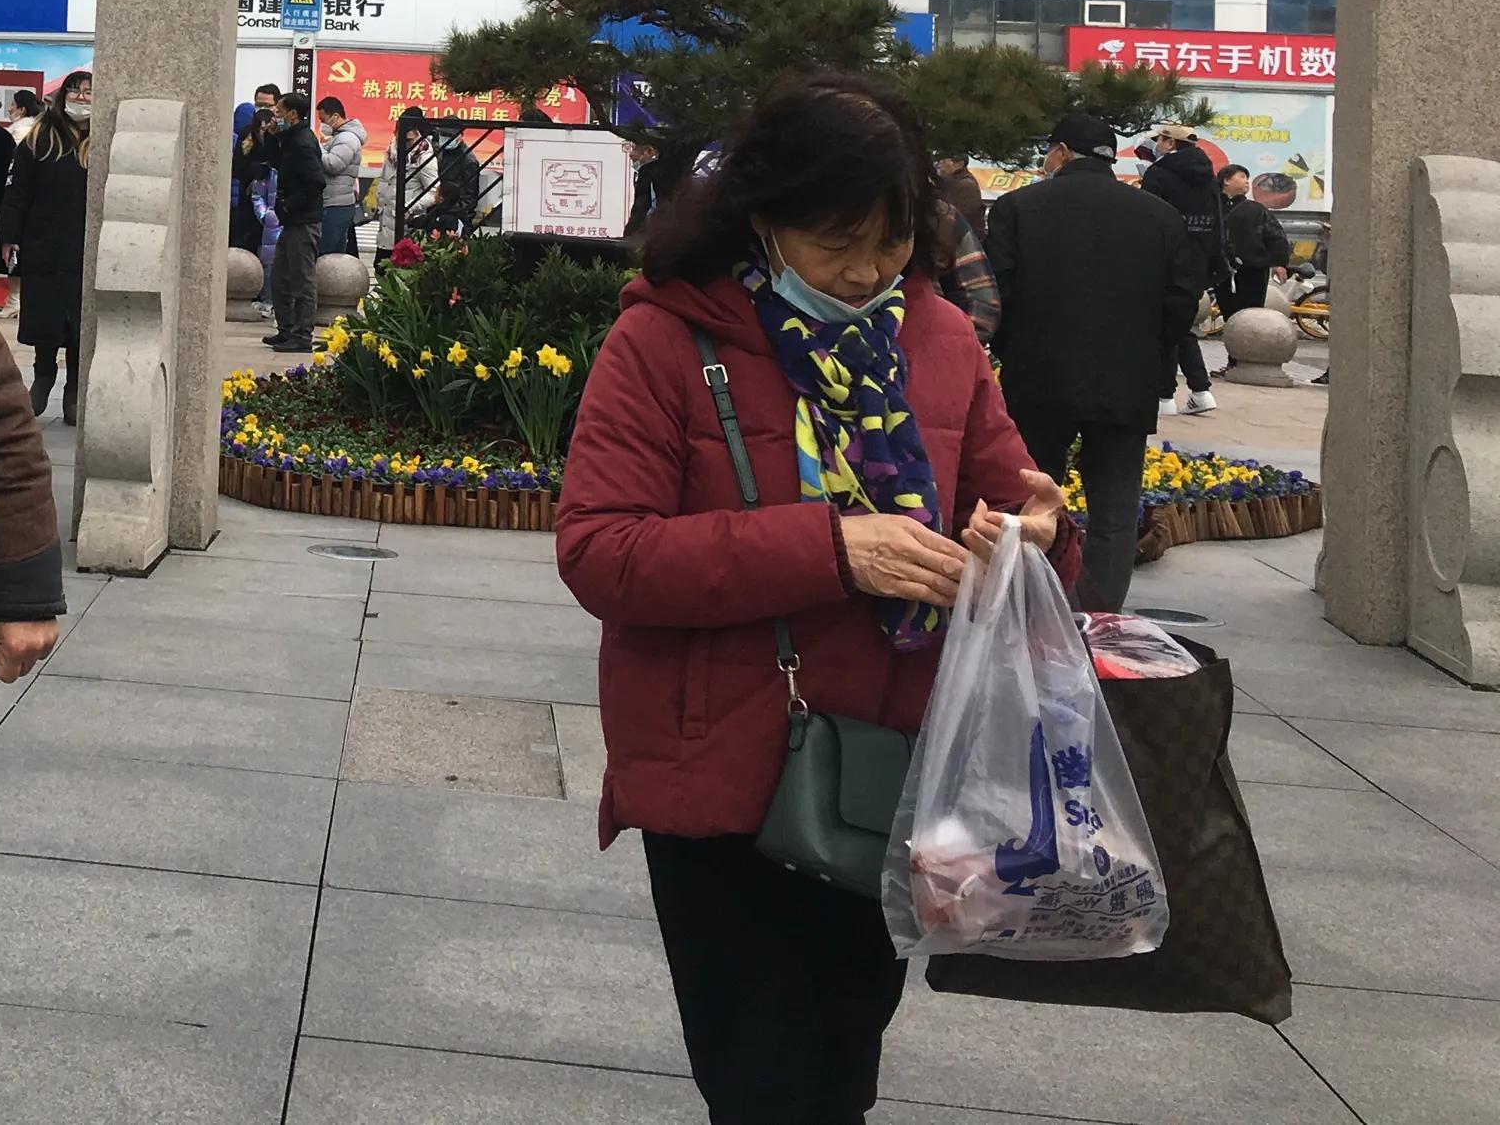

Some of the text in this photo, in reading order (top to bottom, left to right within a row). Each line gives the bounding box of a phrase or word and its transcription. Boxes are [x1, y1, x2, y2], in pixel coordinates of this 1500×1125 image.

[324, 18, 360, 31] Bank
[1134, 41, 1336, 76] 京东手机数
